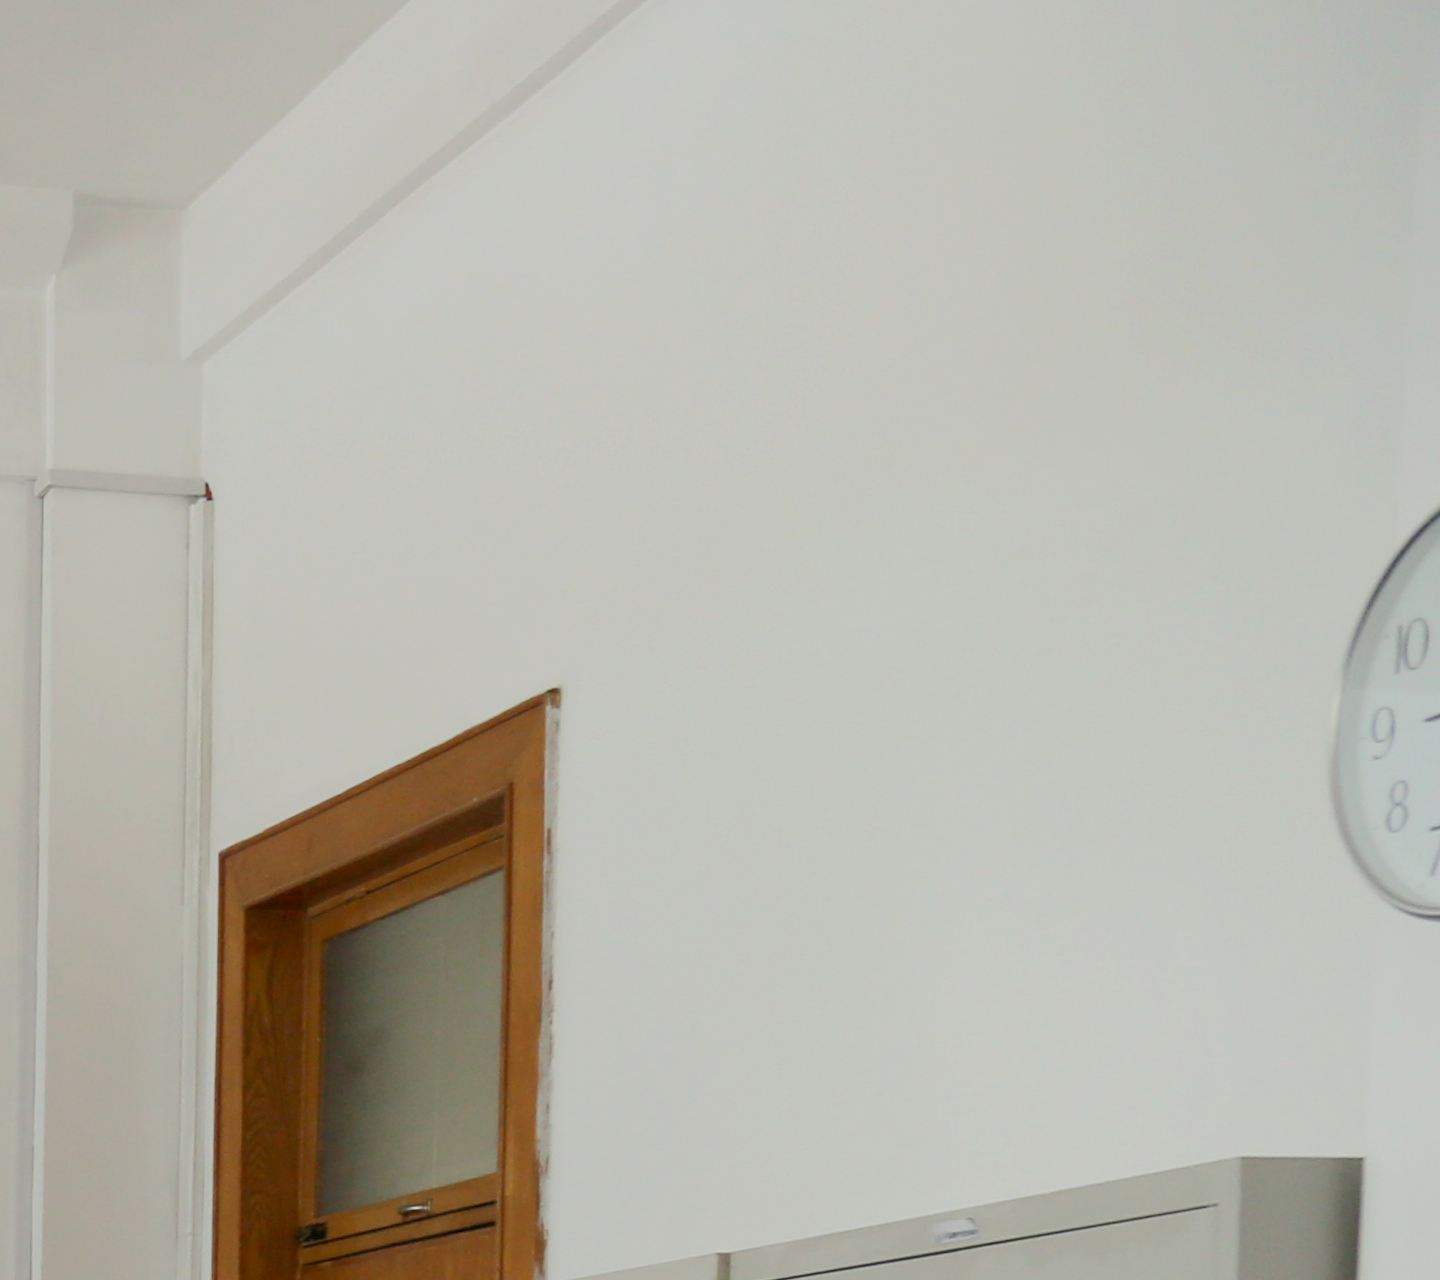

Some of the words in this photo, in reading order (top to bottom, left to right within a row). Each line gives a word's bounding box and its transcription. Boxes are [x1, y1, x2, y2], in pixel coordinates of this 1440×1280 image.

[1394, 617, 1429, 674] 10
[1372, 706, 1396, 760] 9
[1386, 780, 1409, 834] 8
